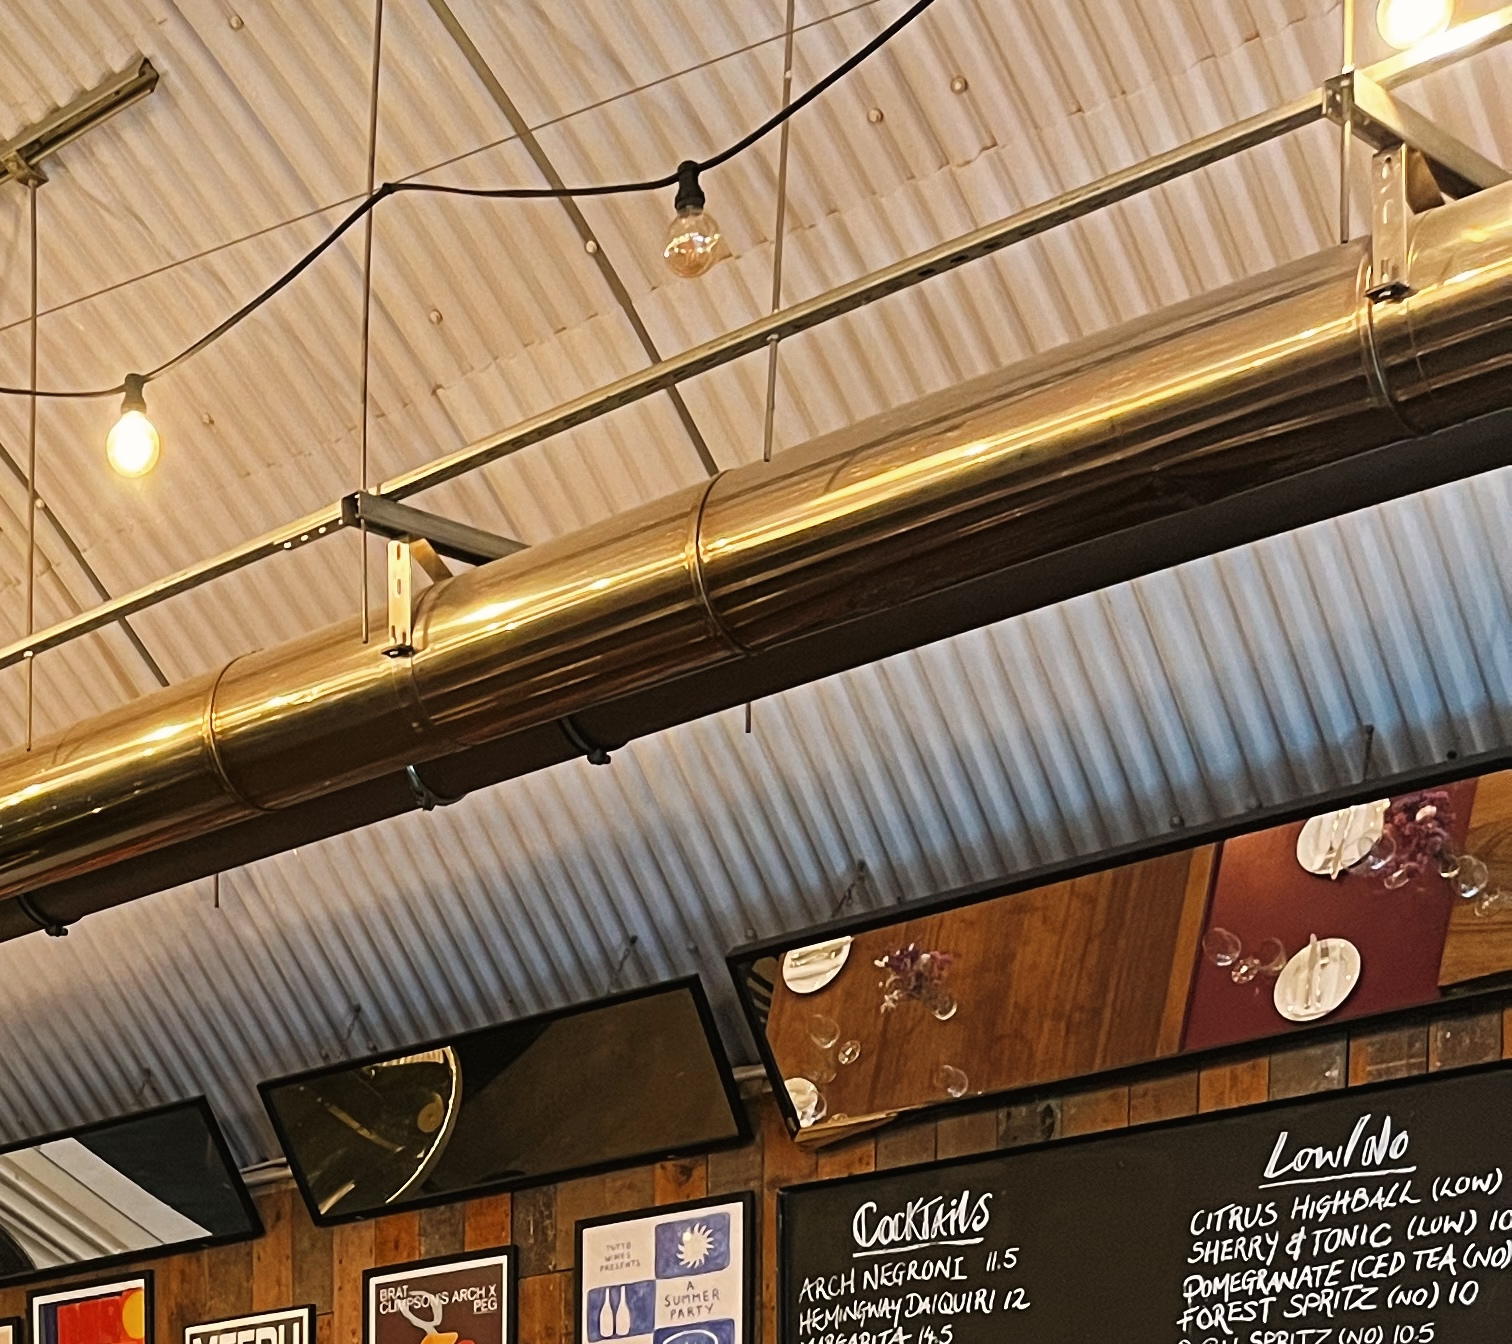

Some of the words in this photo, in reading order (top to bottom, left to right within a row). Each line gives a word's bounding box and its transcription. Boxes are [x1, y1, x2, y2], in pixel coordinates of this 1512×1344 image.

[1190, 1202, 1278, 1235] CITRUS
[1291, 1180, 1421, 1222] HIGHBALL
[1432, 1168, 1503, 1201] (LOW)
[606, 1242, 632, 1251] TUTTO
[1188, 1231, 1279, 1266] SHERRY
[1285, 1226, 1307, 1261] &
[1311, 1223, 1392, 1257] TONIC
[1407, 1209, 1477, 1240] (LOW)
[1350, 1251, 1406, 1282] ICED
[1413, 1243, 1456, 1275] TEA
[686, 1280, 695, 1291] A
[799, 1267, 855, 1303] ARCH
[863, 1256, 967, 1290] NEGRONI
[986, 1247, 1020, 1271] 11.5
[379, 1285, 409, 1302] BRAT
[451, 1286, 486, 1303] ARCH
[664, 1288, 721, 1308] SUMMER
[473, 1297, 498, 1313] PEG
[670, 1303, 714, 1320] PARTY
[799, 1297, 902, 1335] HEMINGWAY
[904, 1288, 995, 1318] DAIQUIRI
[1003, 1288, 1031, 1310] 12
[1176, 1297, 1277, 1334] FOREST
[1283, 1284, 1378, 1317] SPRITZ
[1387, 1281, 1439, 1308] (NO)
[1448, 1280, 1479, 1305] 10
[1393, 1322, 1435, 1344] 10.5
